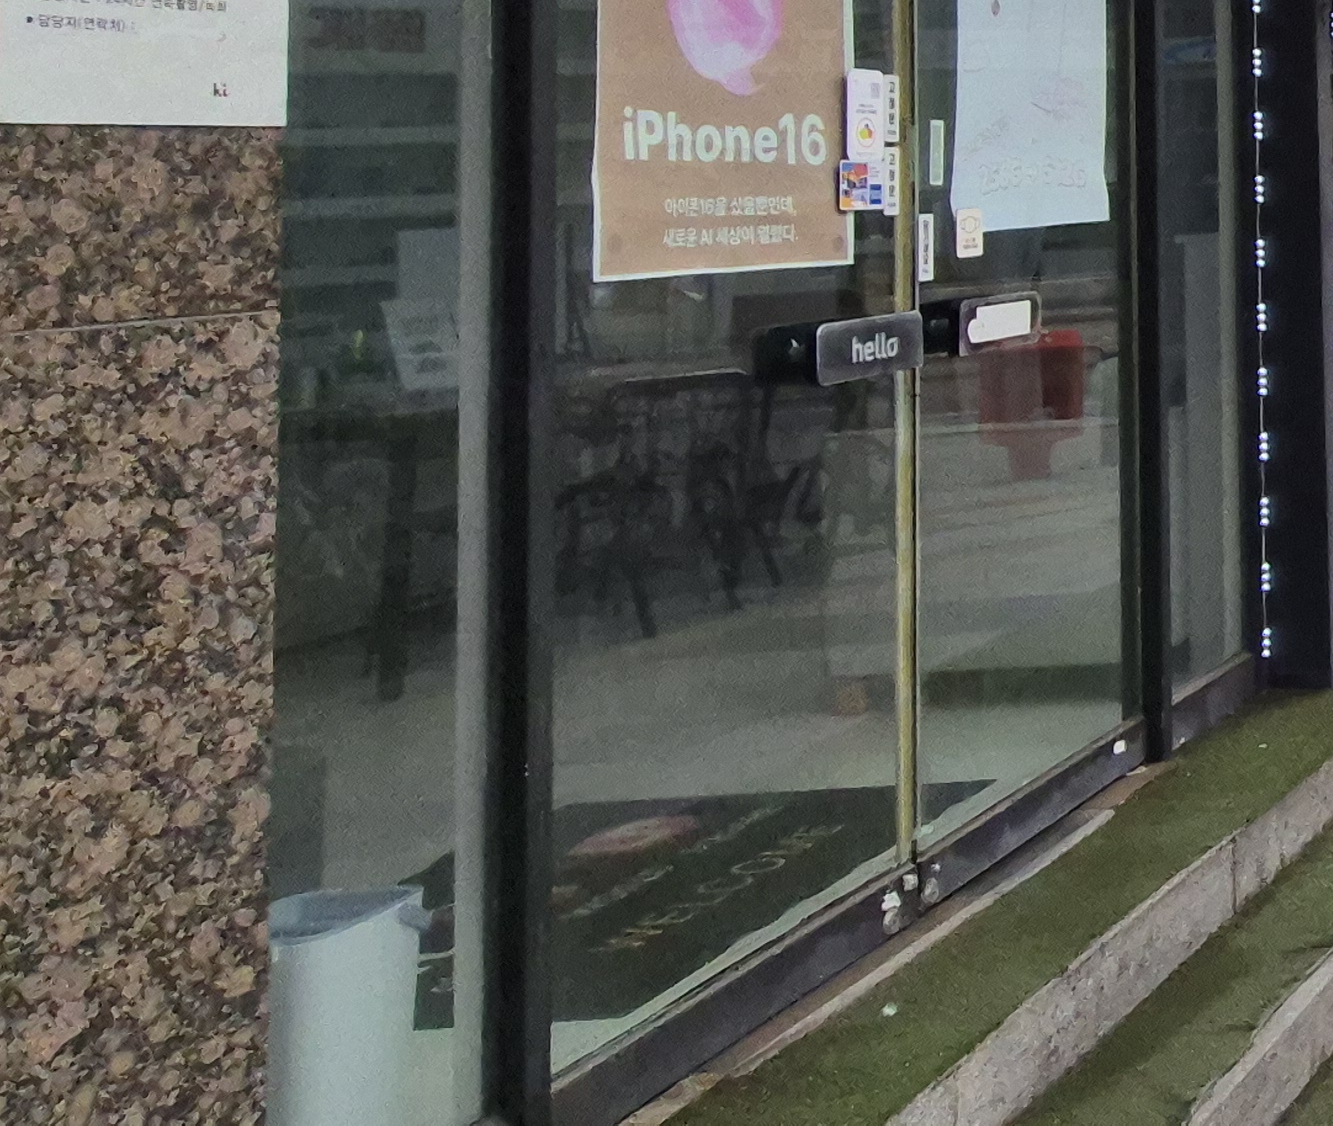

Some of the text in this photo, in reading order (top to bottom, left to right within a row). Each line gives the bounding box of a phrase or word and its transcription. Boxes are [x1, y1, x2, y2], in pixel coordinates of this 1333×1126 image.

[622, 105, 828, 166] iPhone16
[664, 196, 728, 218] 아이폰16을
[662, 227, 699, 248] 새로운
[699, 228, 713, 246] AI
[715, 224, 755, 246] 세상이
[850, 332, 900, 365] hello
